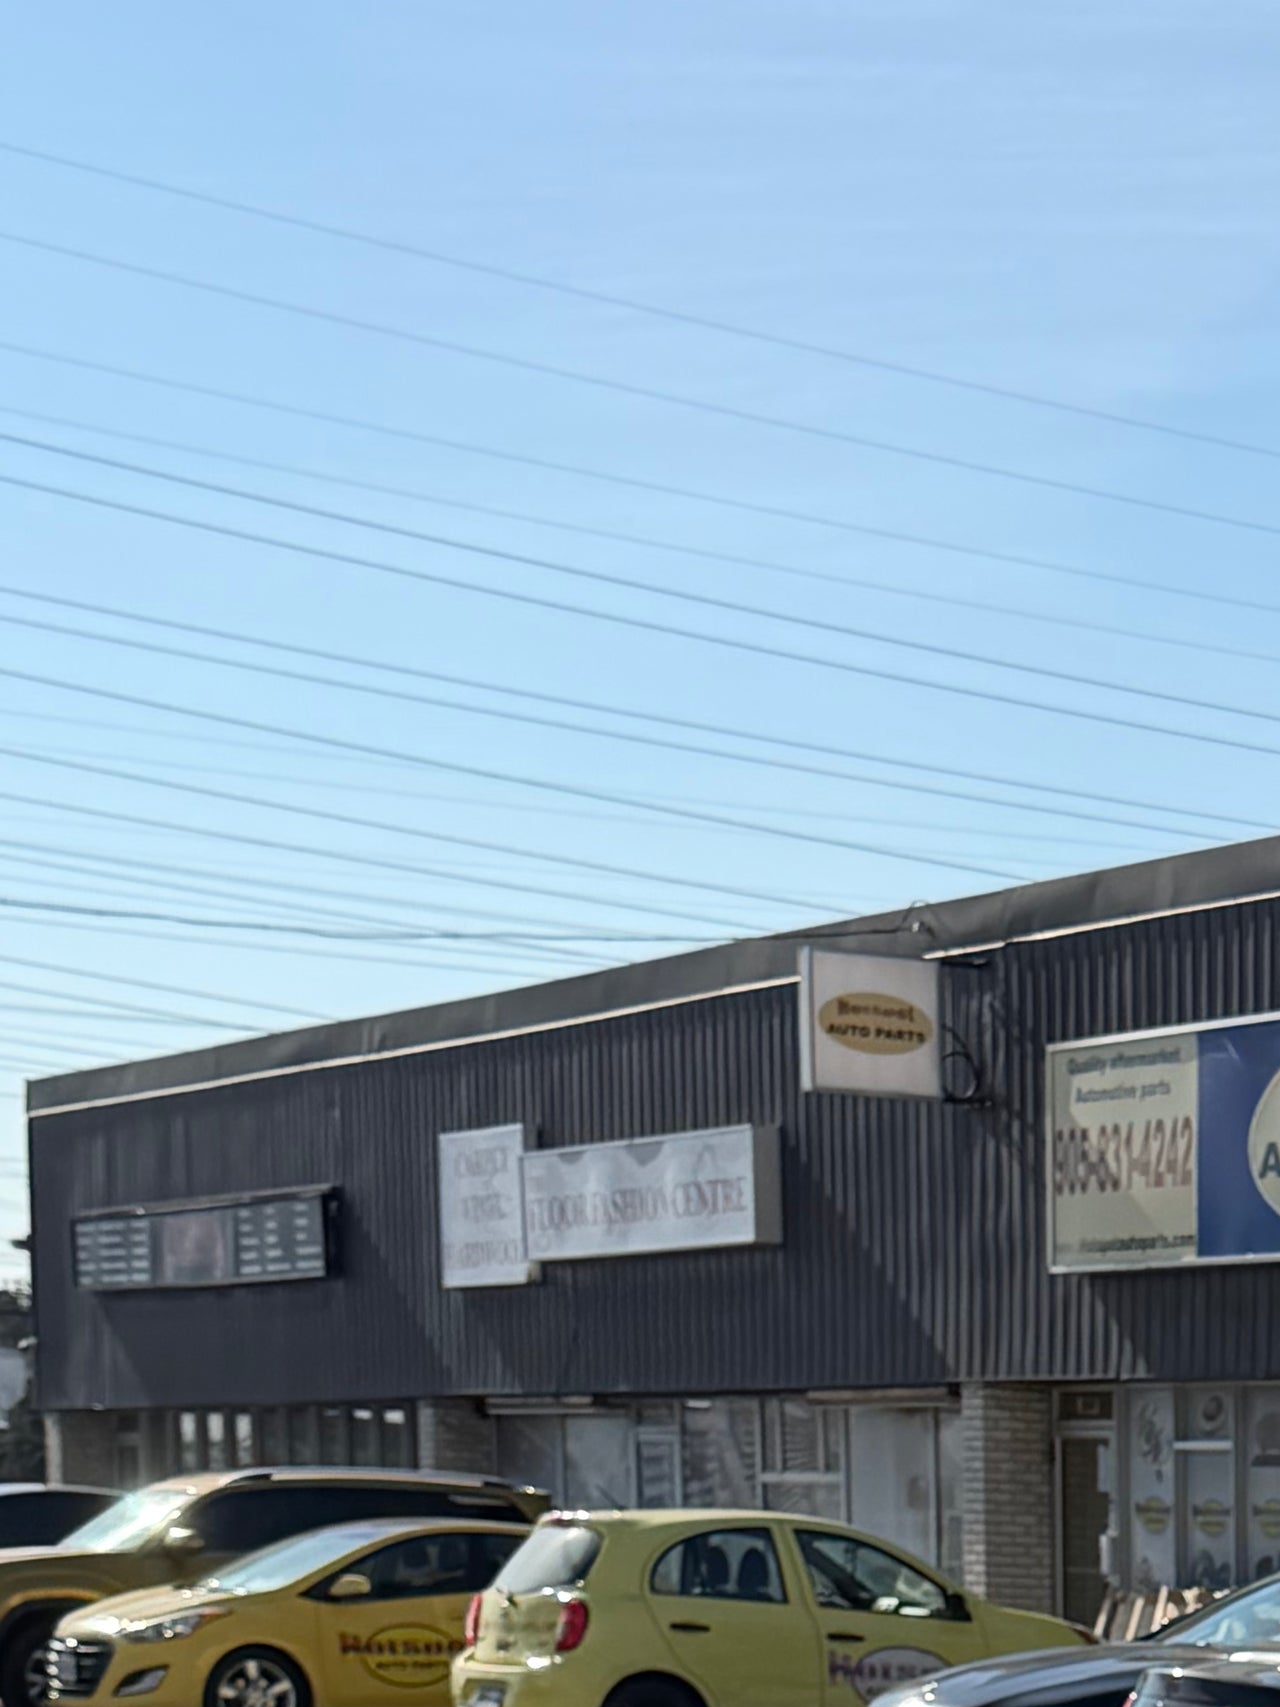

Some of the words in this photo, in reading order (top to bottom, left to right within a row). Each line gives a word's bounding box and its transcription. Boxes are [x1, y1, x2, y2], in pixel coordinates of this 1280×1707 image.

[826, 1023, 870, 1038] AUTO
[875, 1026, 925, 1044] PARTS
[1140, 1080, 1170, 1102] parts
[672, 1176, 748, 1219] CENTRE
